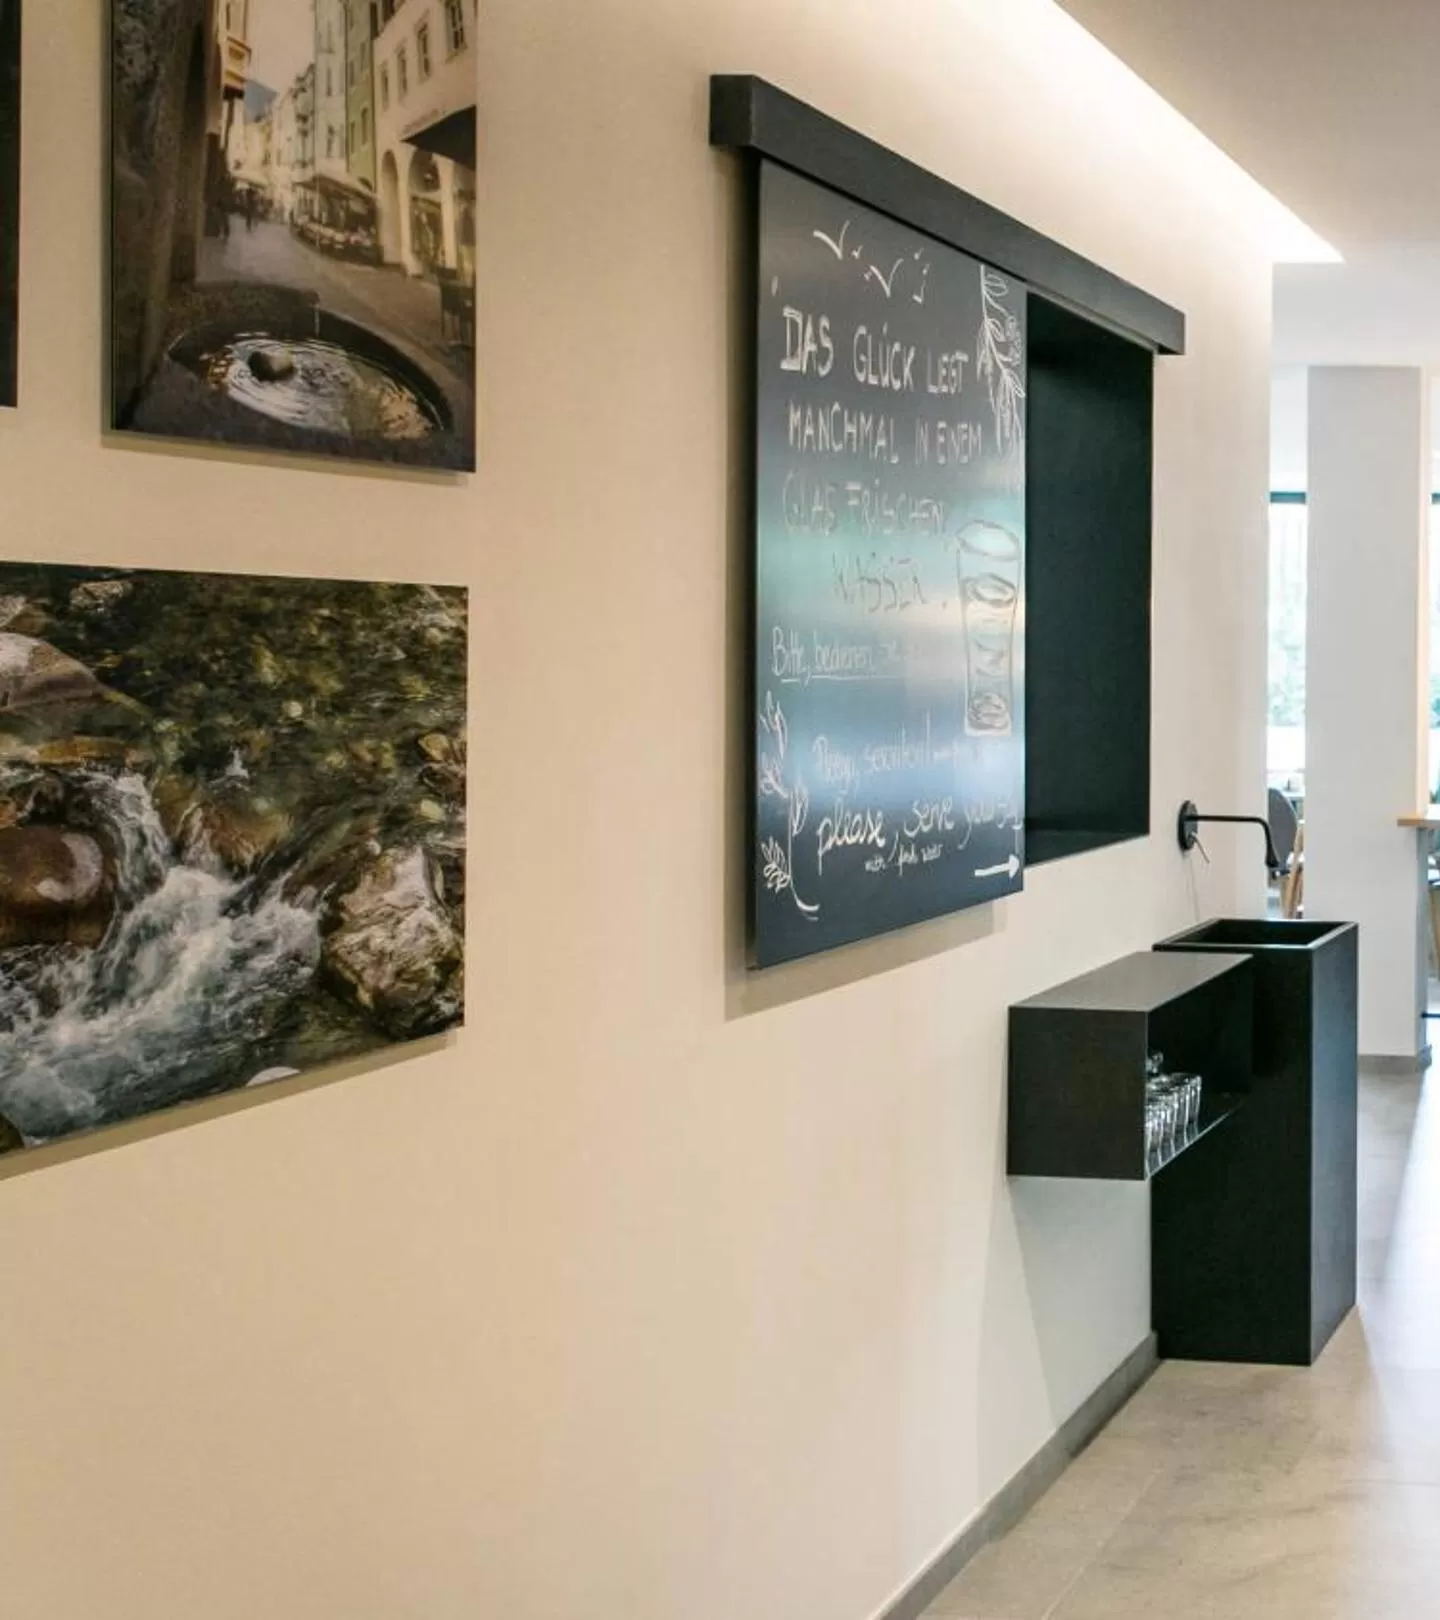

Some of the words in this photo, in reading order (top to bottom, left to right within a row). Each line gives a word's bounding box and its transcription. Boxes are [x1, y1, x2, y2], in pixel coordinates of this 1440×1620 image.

[780, 305, 835, 377] DAS
[853, 321, 916, 391] GLÜCK
[788, 400, 900, 464] MANCHMAL
